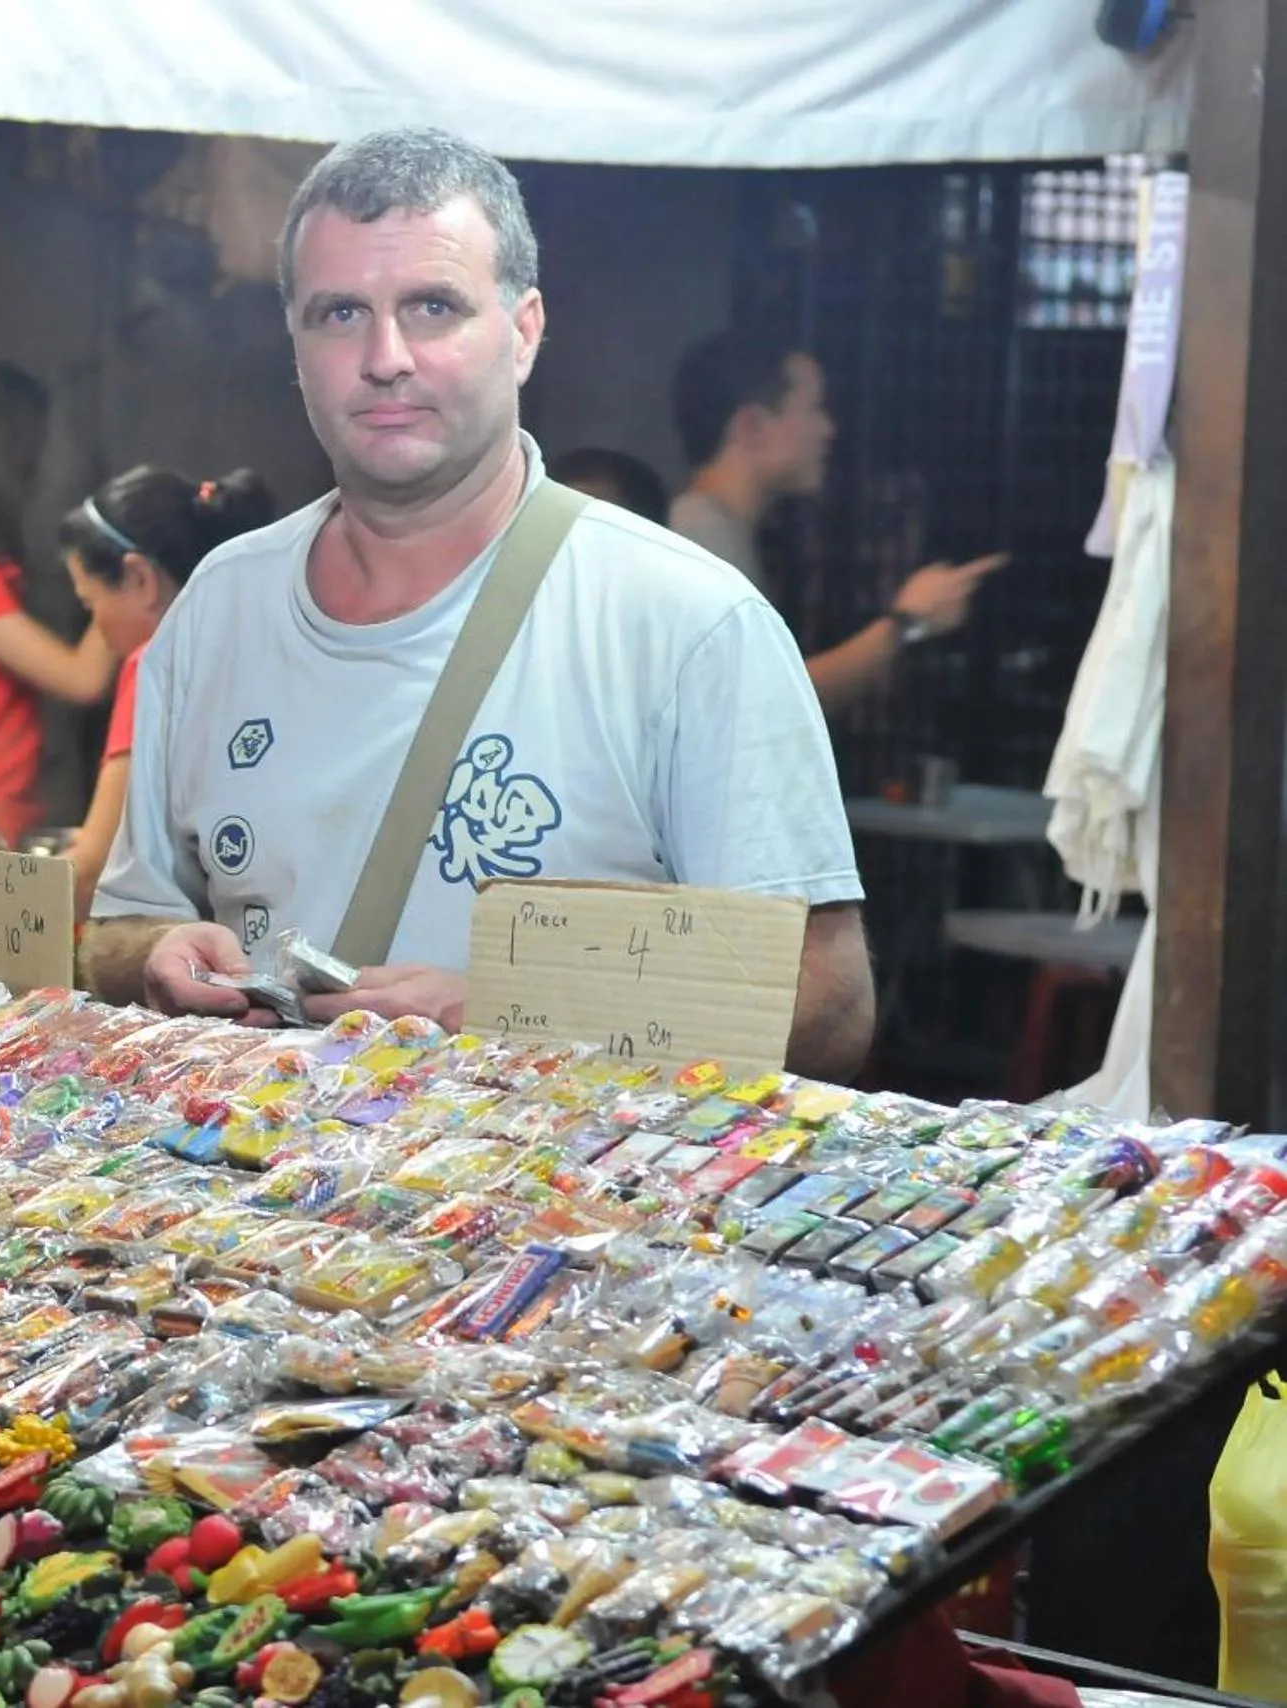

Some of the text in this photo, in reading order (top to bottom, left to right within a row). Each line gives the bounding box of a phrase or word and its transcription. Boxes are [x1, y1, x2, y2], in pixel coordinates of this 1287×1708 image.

[1129, 286, 1172, 369] THE
[5, 863, 15, 894] 6
[4, 923, 21, 954] 10
[520, 901, 568, 928] Piece
[628, 926, 650, 983] 4
[663, 907, 693, 936] RM
[510, 1003, 549, 1028] Piece
